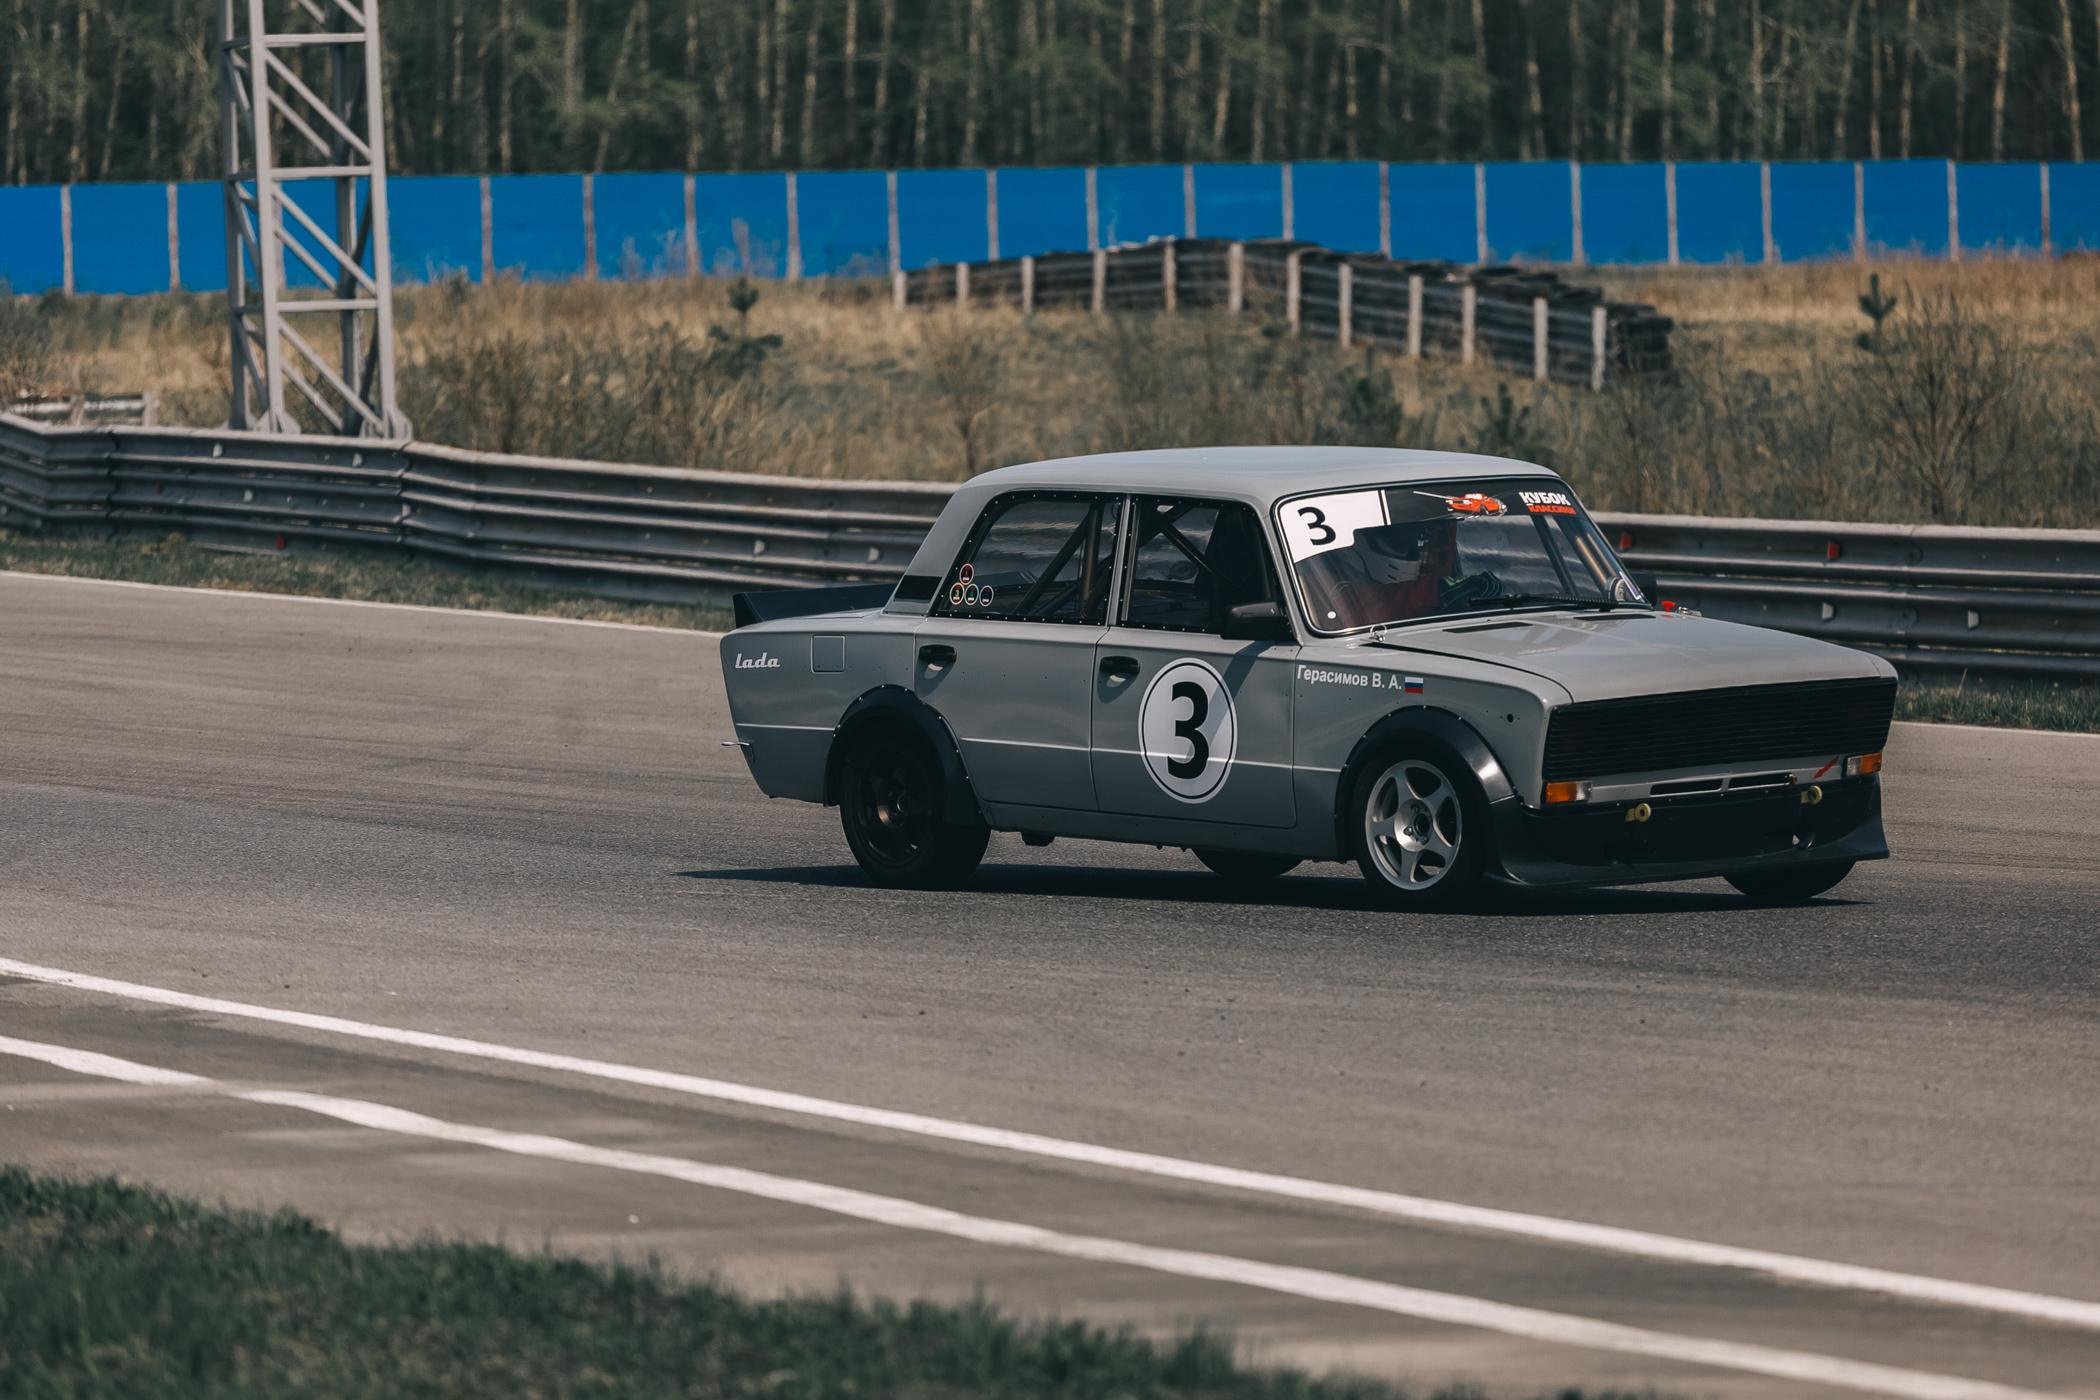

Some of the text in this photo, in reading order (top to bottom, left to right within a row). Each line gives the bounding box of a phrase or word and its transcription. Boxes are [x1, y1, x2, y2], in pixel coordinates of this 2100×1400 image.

[1518, 491, 1572, 506] КУБОК
[1297, 506, 1336, 546] 3
[1297, 664, 1402, 690] Герасимов В. А.
[1168, 681, 1209, 780] 3
